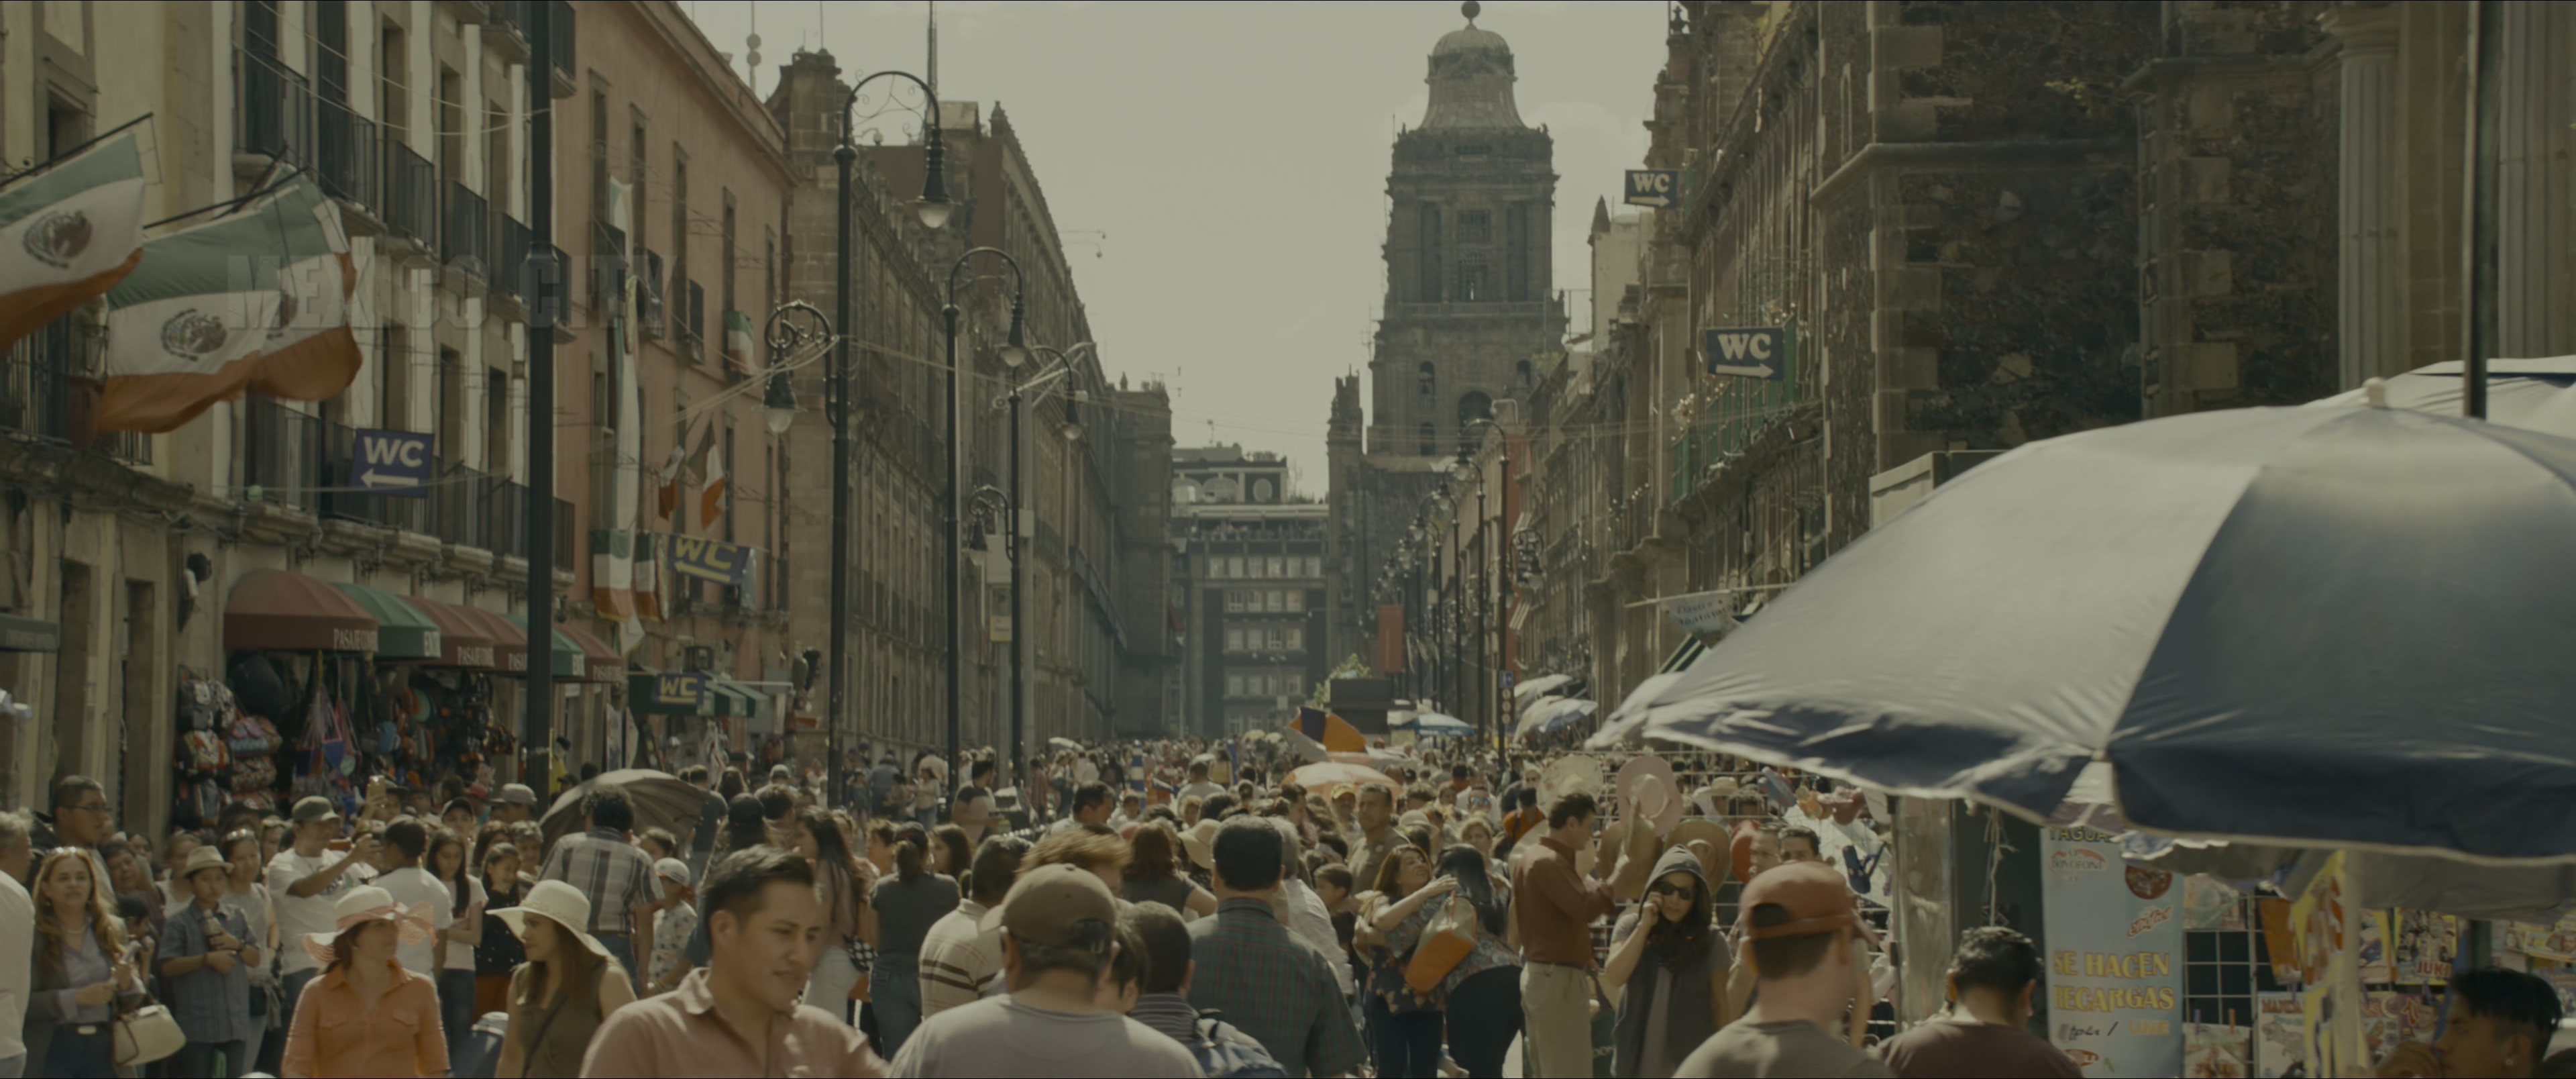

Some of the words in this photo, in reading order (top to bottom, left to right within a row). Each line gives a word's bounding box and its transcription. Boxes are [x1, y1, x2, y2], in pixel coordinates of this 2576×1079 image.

[1631, 172, 1670, 193] WC
[1717, 333, 1772, 360] WC
[364, 436, 425, 468] WC
[676, 537, 737, 570] WC
[660, 676, 698, 697] WC
[2054, 950, 2078, 976] SE
[2084, 951, 2170, 980] HACEN
[2053, 985, 2175, 1013] RECARGAS
